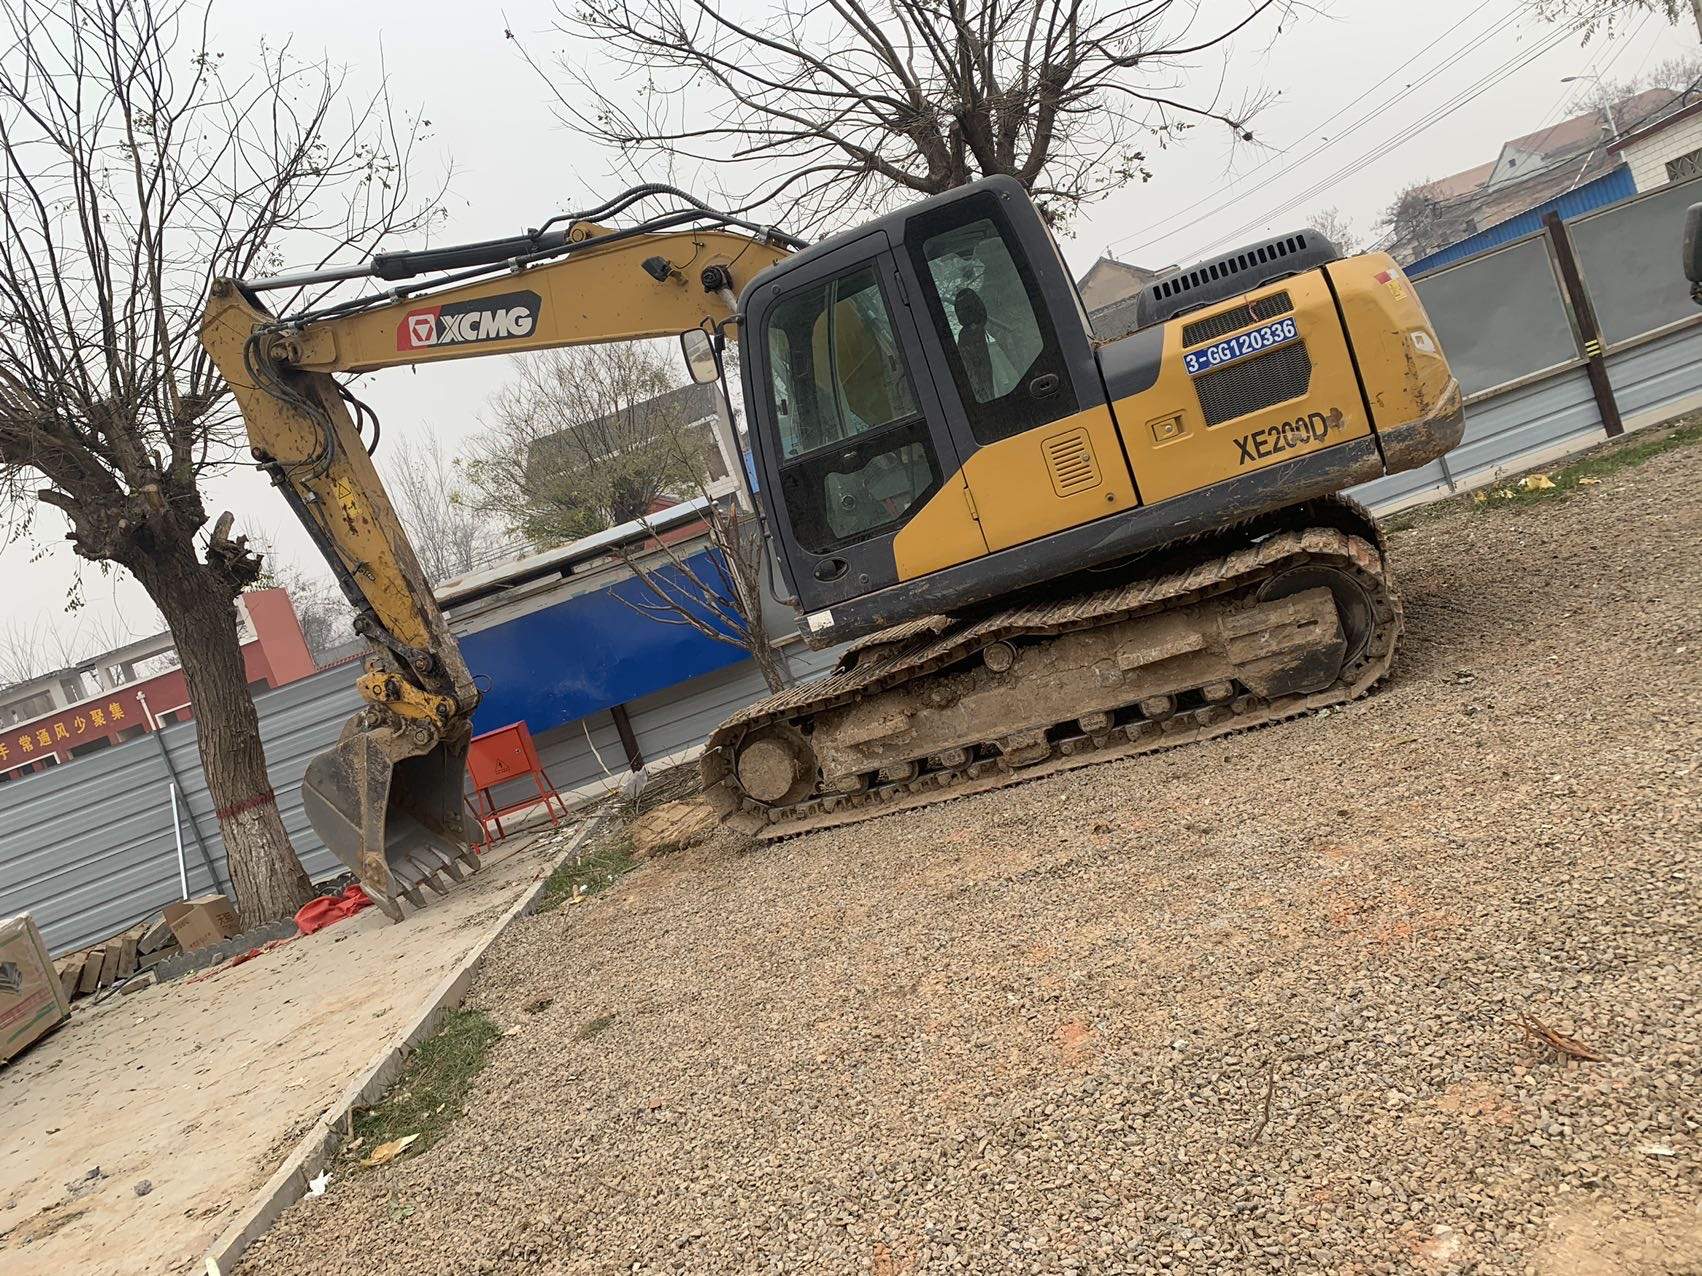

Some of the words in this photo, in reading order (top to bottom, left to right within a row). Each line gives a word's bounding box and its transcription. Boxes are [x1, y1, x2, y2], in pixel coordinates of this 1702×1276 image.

[438, 306, 533, 344] XCMG
[1186, 320, 1296, 372] 3-GG120336
[1233, 412, 1328, 465] XE200D
